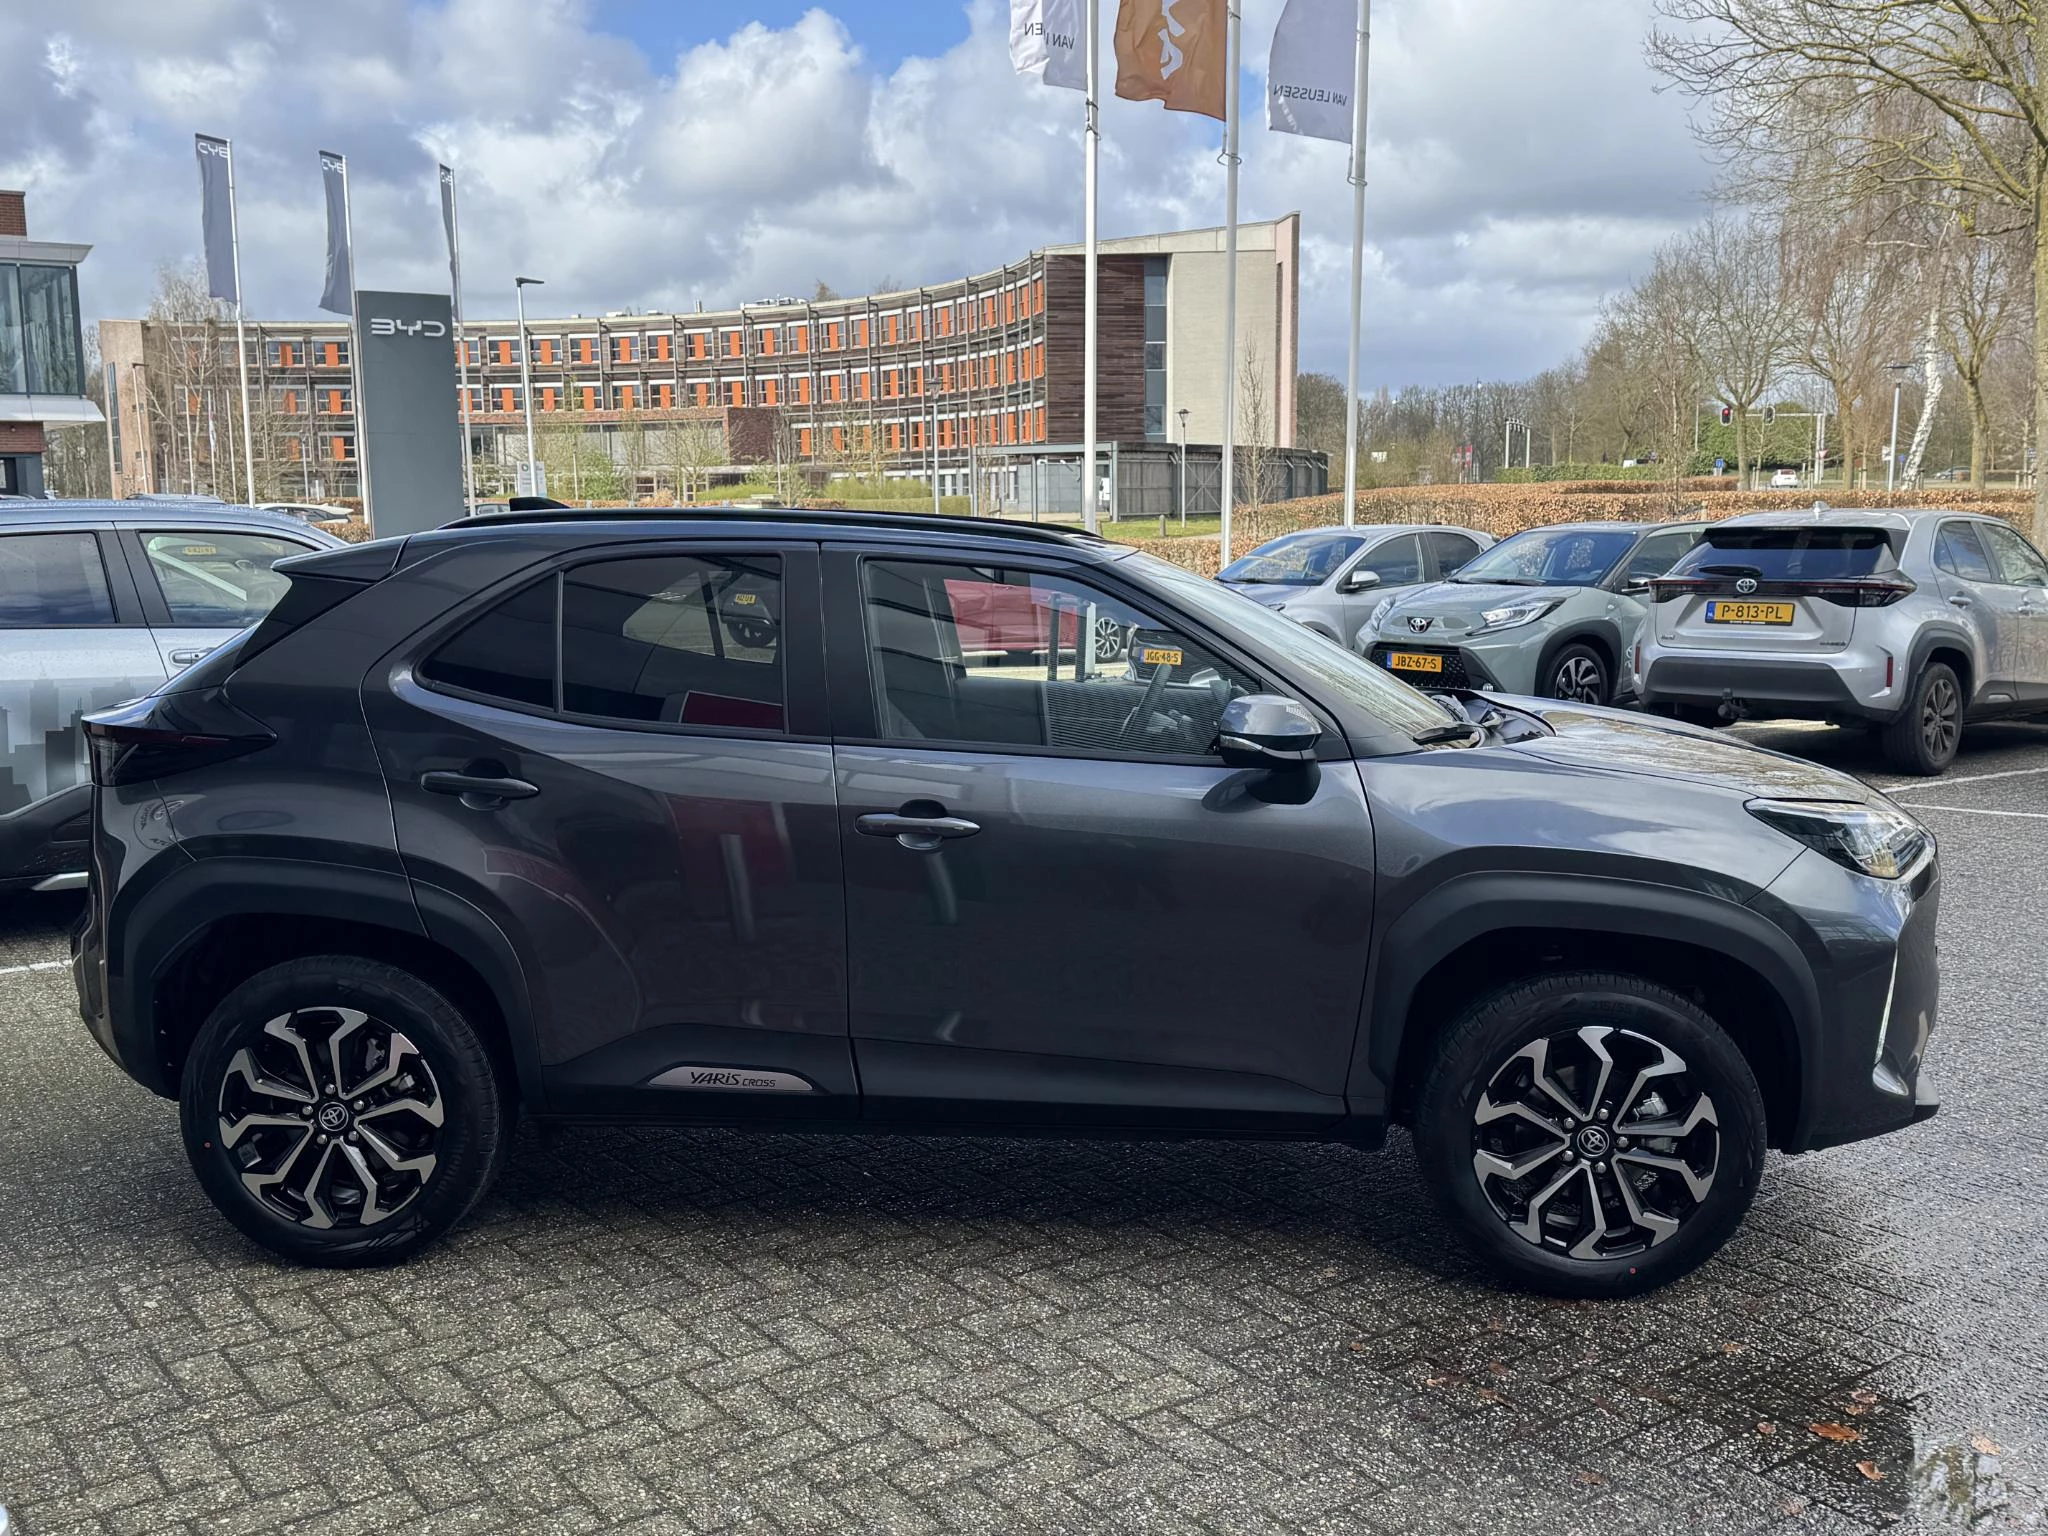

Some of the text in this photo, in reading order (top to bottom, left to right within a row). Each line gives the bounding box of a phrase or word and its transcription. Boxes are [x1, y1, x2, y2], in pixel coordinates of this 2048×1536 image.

[371, 318, 446, 337] BYD
[1721, 605, 1783, 619] P-813-PL
[1145, 650, 1179, 663] JGG-48-S
[1395, 655, 1437, 669] JBZ-67-S
[742, 1078, 776, 1088] CROSS
